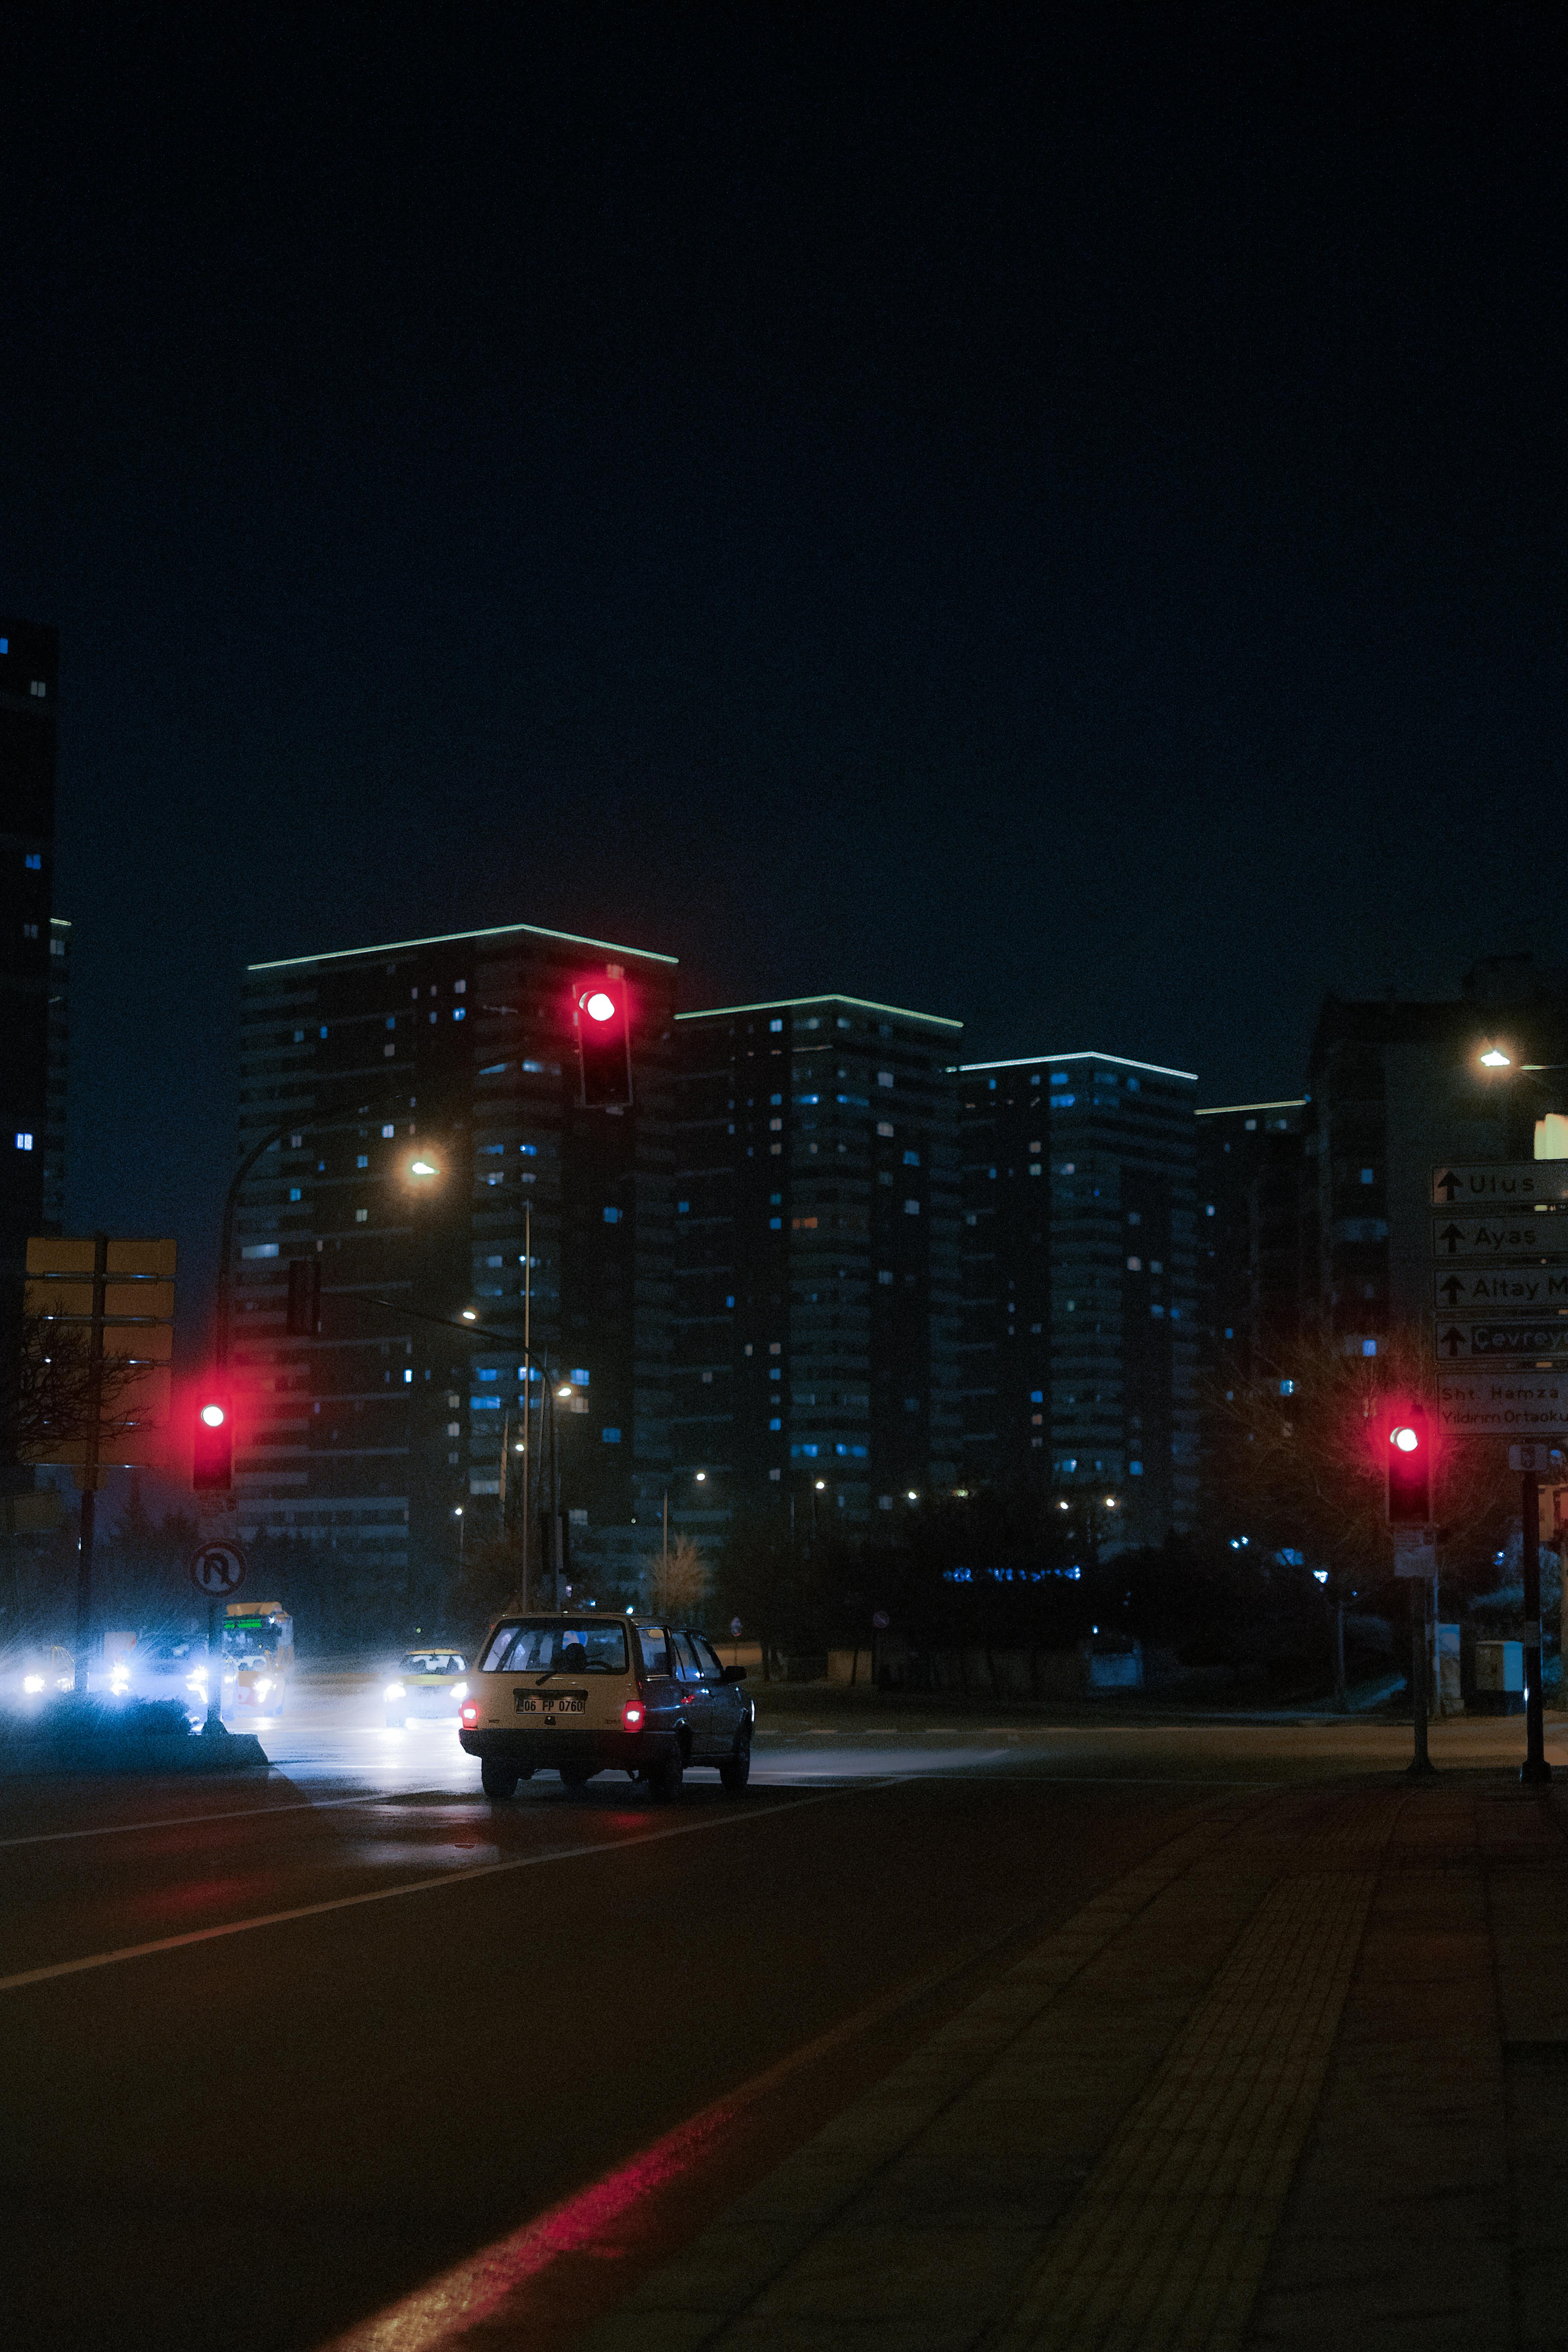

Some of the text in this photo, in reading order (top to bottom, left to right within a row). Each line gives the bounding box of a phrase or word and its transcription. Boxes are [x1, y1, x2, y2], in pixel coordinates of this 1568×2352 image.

[1471, 1175, 1534, 1193] Ulus
[1473, 1279, 1539, 1300] Altay
[1491, 1385, 1559, 1400] Hamza
[524, 1700, 536, 1712] 06
[559, 1701, 583, 1712] 0760
